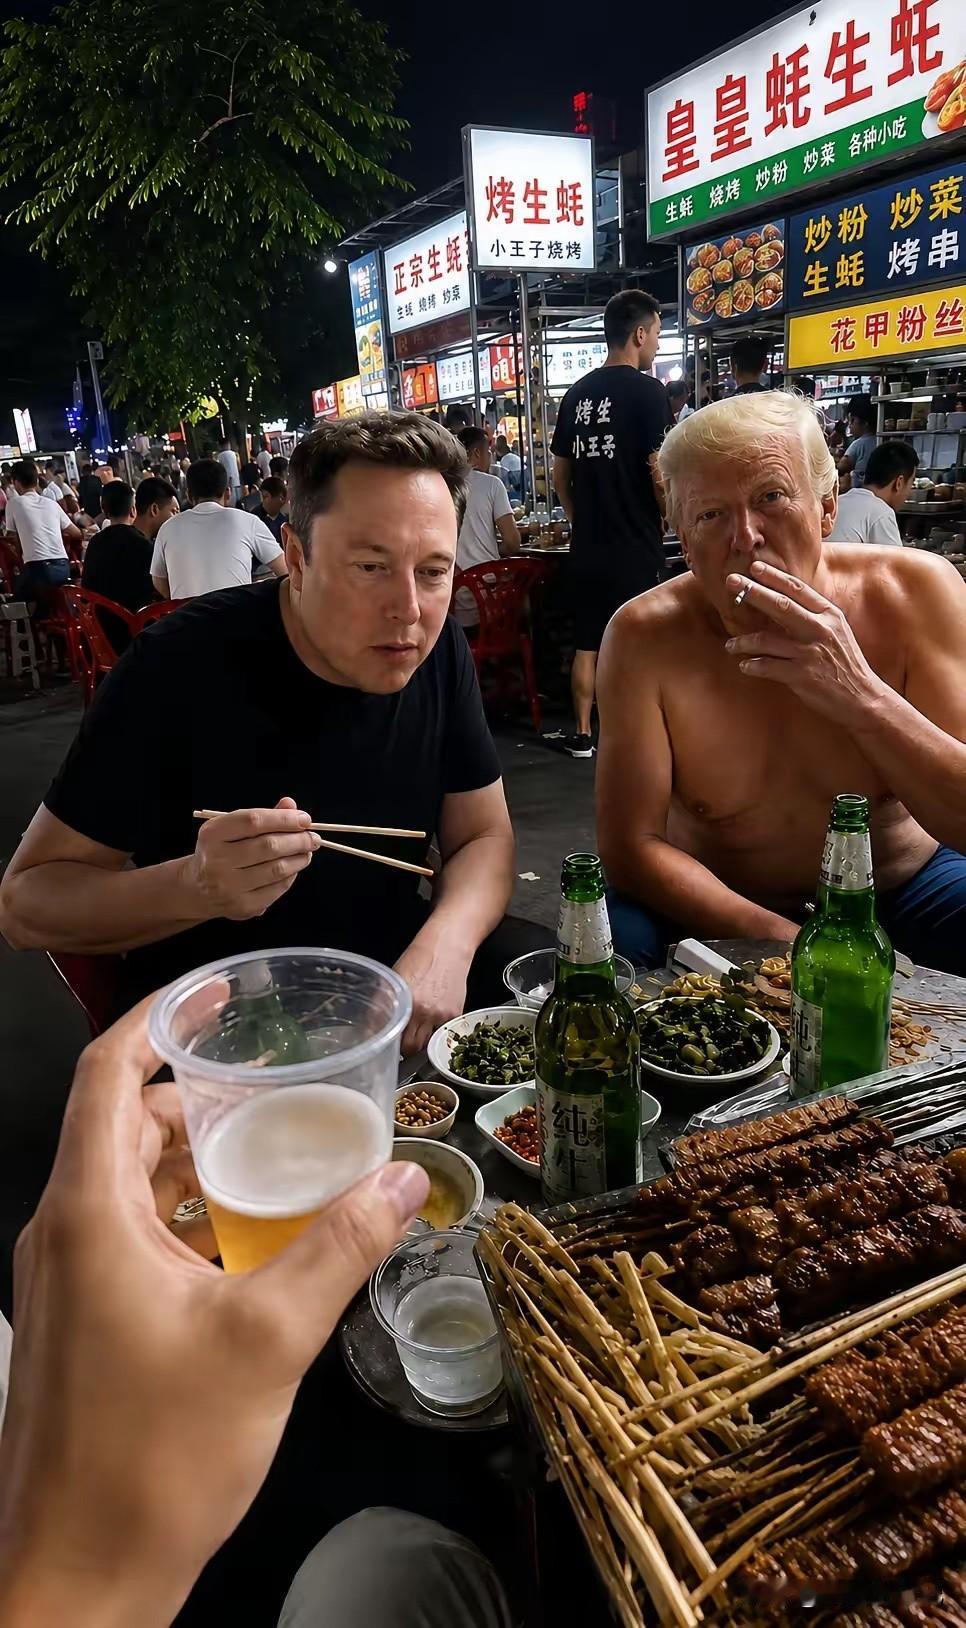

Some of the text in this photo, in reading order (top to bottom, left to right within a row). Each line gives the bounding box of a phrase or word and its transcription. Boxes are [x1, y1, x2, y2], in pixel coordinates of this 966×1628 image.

[662, 0, 944, 183] 皇皇蚝生蚝
[485, 175, 585, 227] 烤生蚝
[665, 115, 907, 225] 生蚝 烧烤 炒粉 炒菜 各种小吃
[803, 175, 964, 254] 炒粉 炒菜
[393, 231, 470, 296] 正宗生蚝
[490, 238, 582, 260] 小王子烧烤
[802, 228, 960, 298] 生蚝 烤串
[829, 297, 966, 354] 花甲粉丝
[574, 397, 612, 425] 烤生
